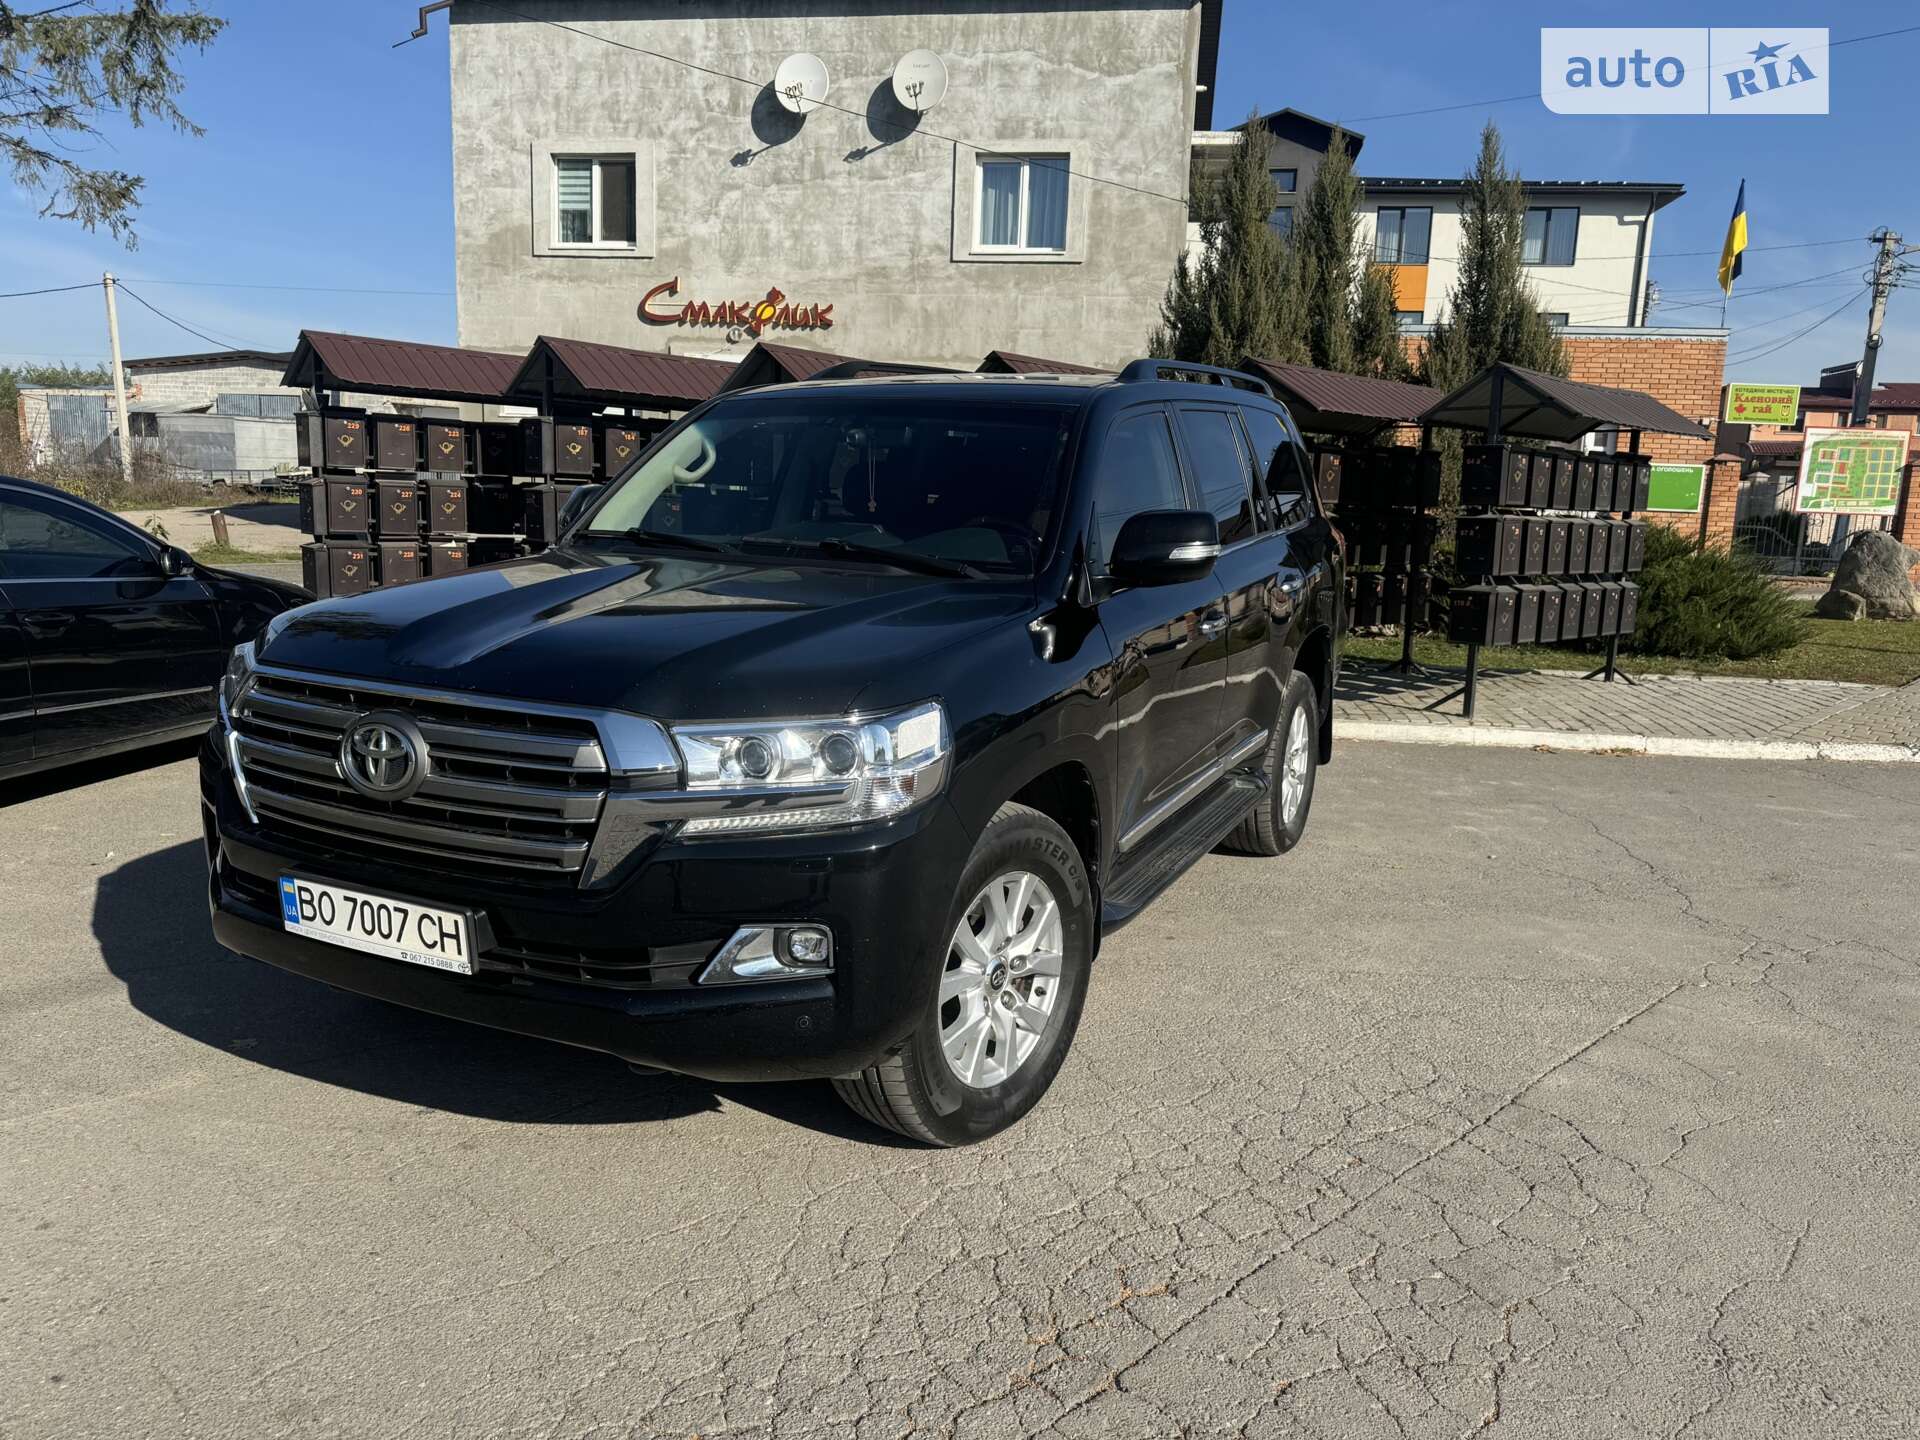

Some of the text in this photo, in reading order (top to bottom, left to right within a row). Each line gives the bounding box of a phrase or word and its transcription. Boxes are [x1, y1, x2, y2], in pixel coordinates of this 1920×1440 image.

[1734, 392, 1793, 404] Кленовий
[1752, 404, 1772, 414] гай
[286, 904, 298, 918] UA
[297, 885, 337, 927] BO
[343, 895, 409, 943] 7007
[417, 913, 463, 956] CH
[409, 952, 422, 963] 067
[423, 956, 436, 966] 215
